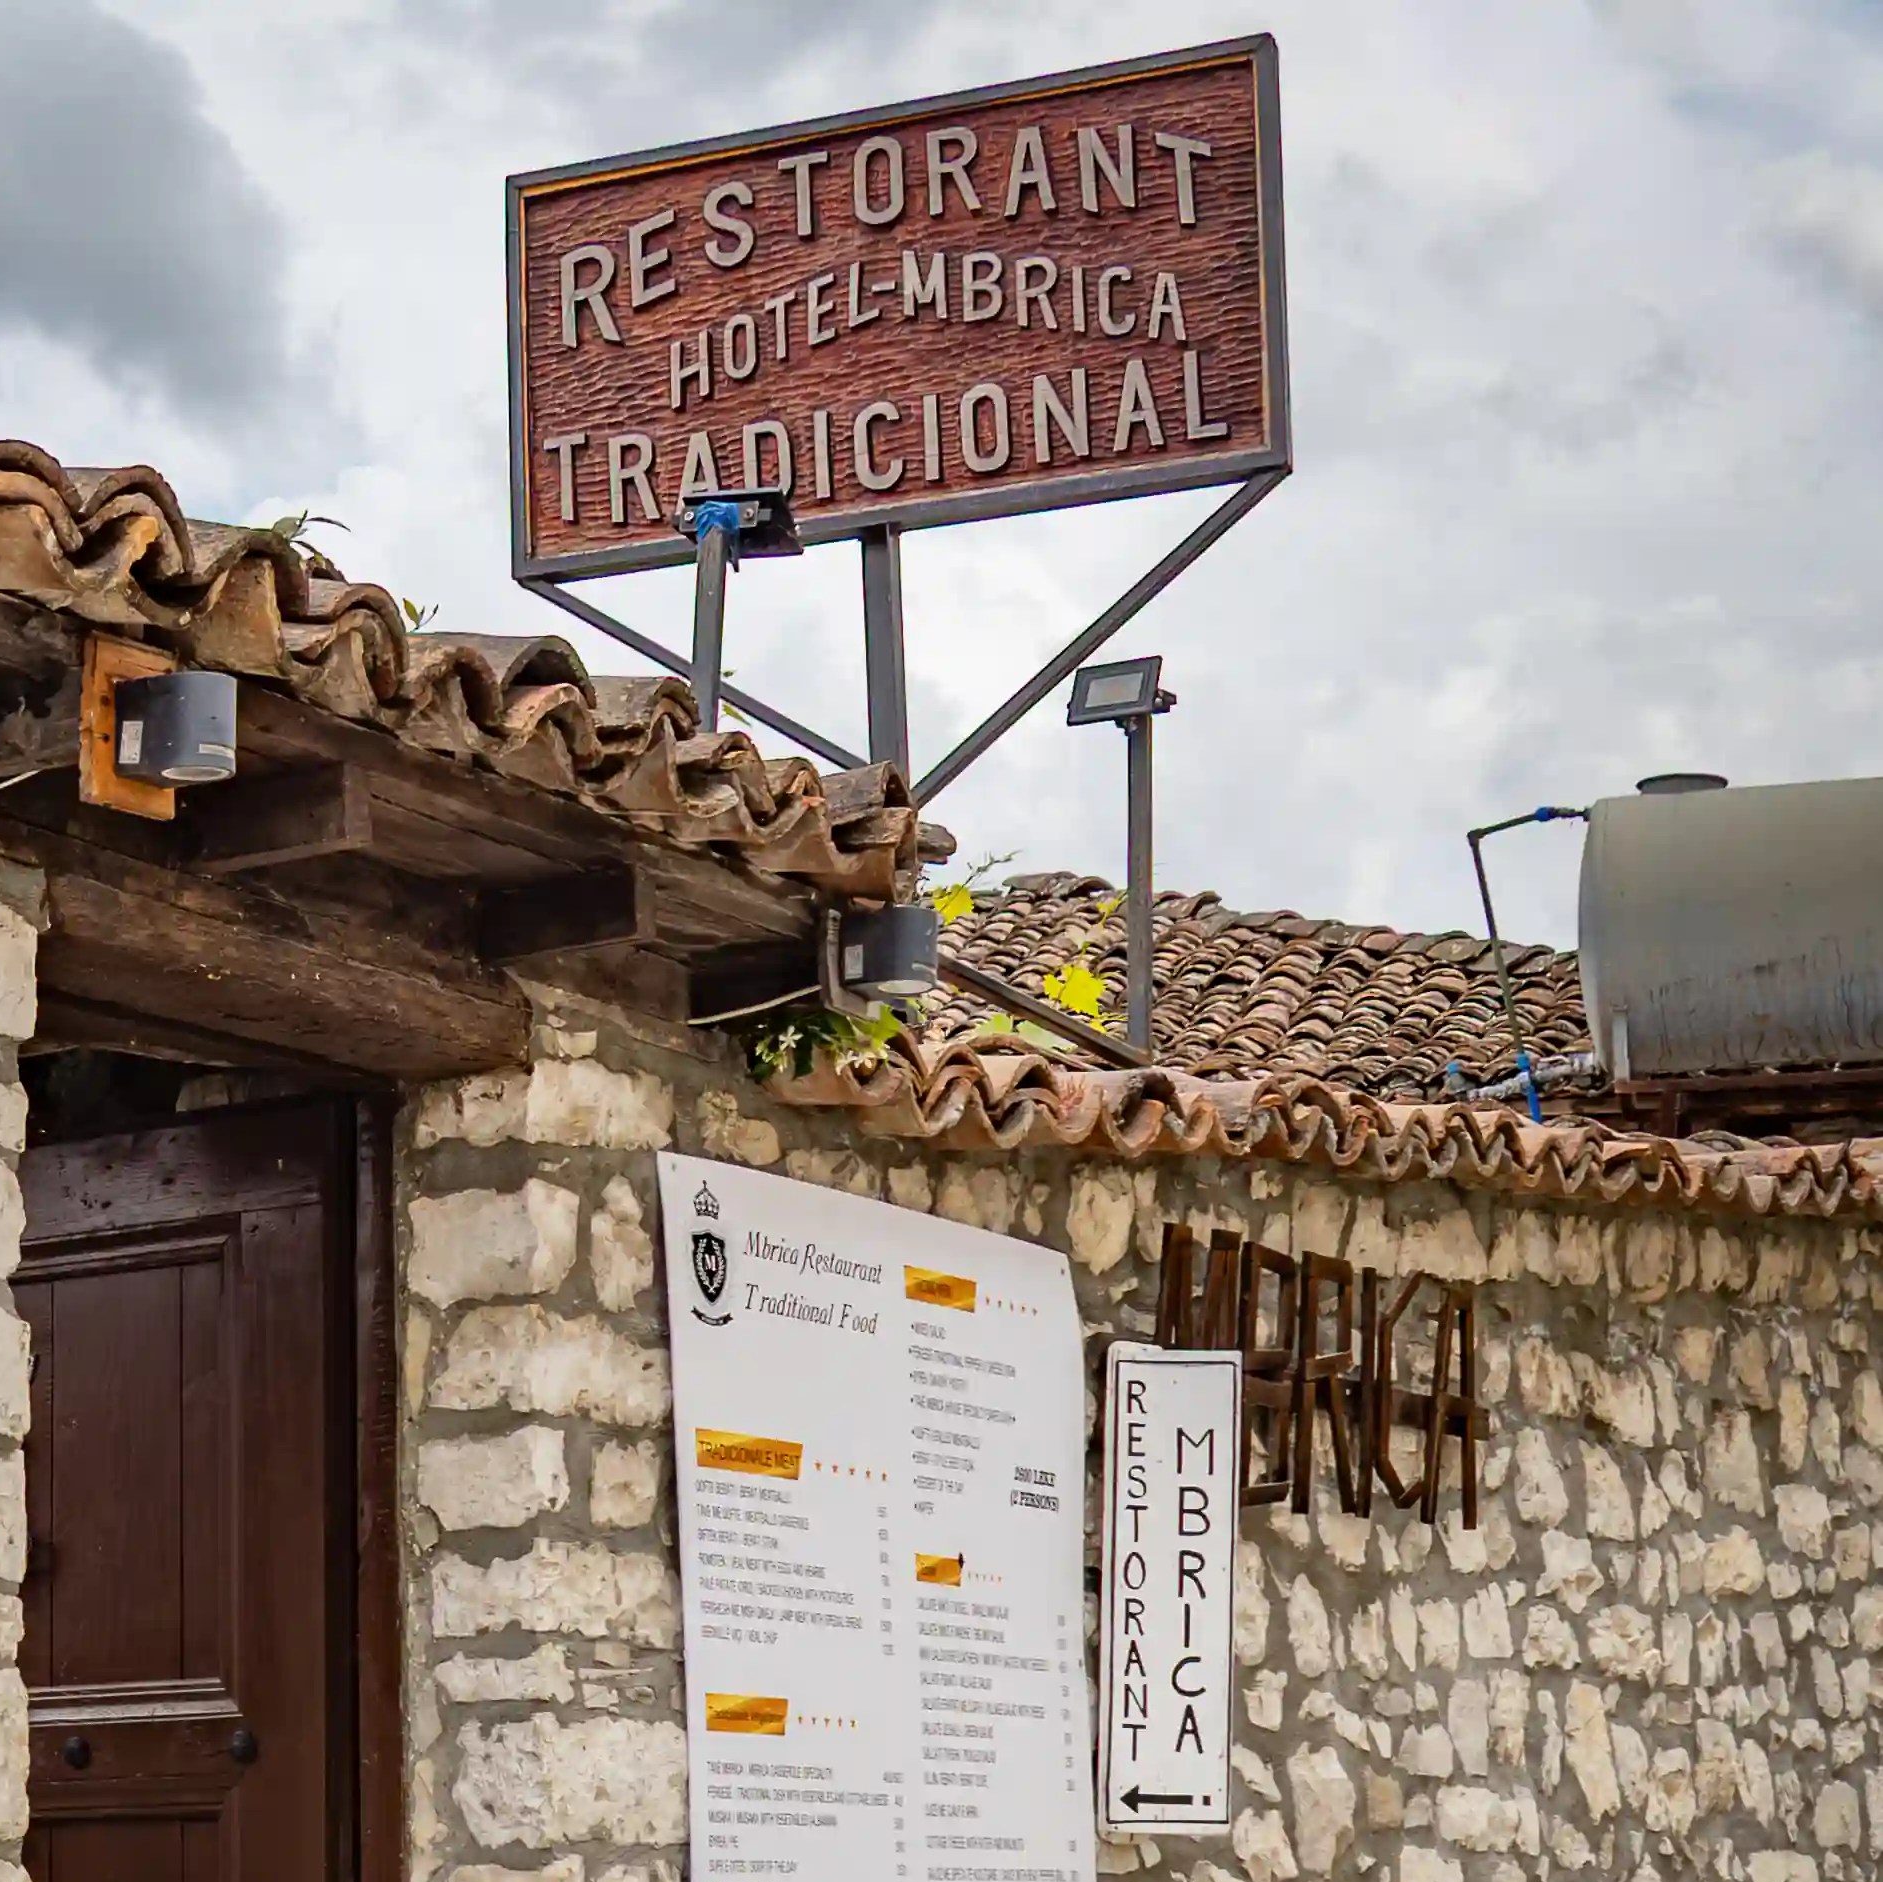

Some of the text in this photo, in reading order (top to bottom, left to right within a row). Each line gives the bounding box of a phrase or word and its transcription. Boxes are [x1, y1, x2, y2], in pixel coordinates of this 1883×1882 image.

[559, 124, 1214, 349] RESTORANT
[668, 249, 1187, 411] HOTEL-MBRICA
[541, 349, 1230, 525] TRADICIONAL
[742, 1230, 883, 1286] Mbrica Restaurant
[837, 1302, 879, 1335] Food
[1122, 1379, 1148, 1764] RESTORANT
[1170, 1426, 1215, 1756] MBRICA
